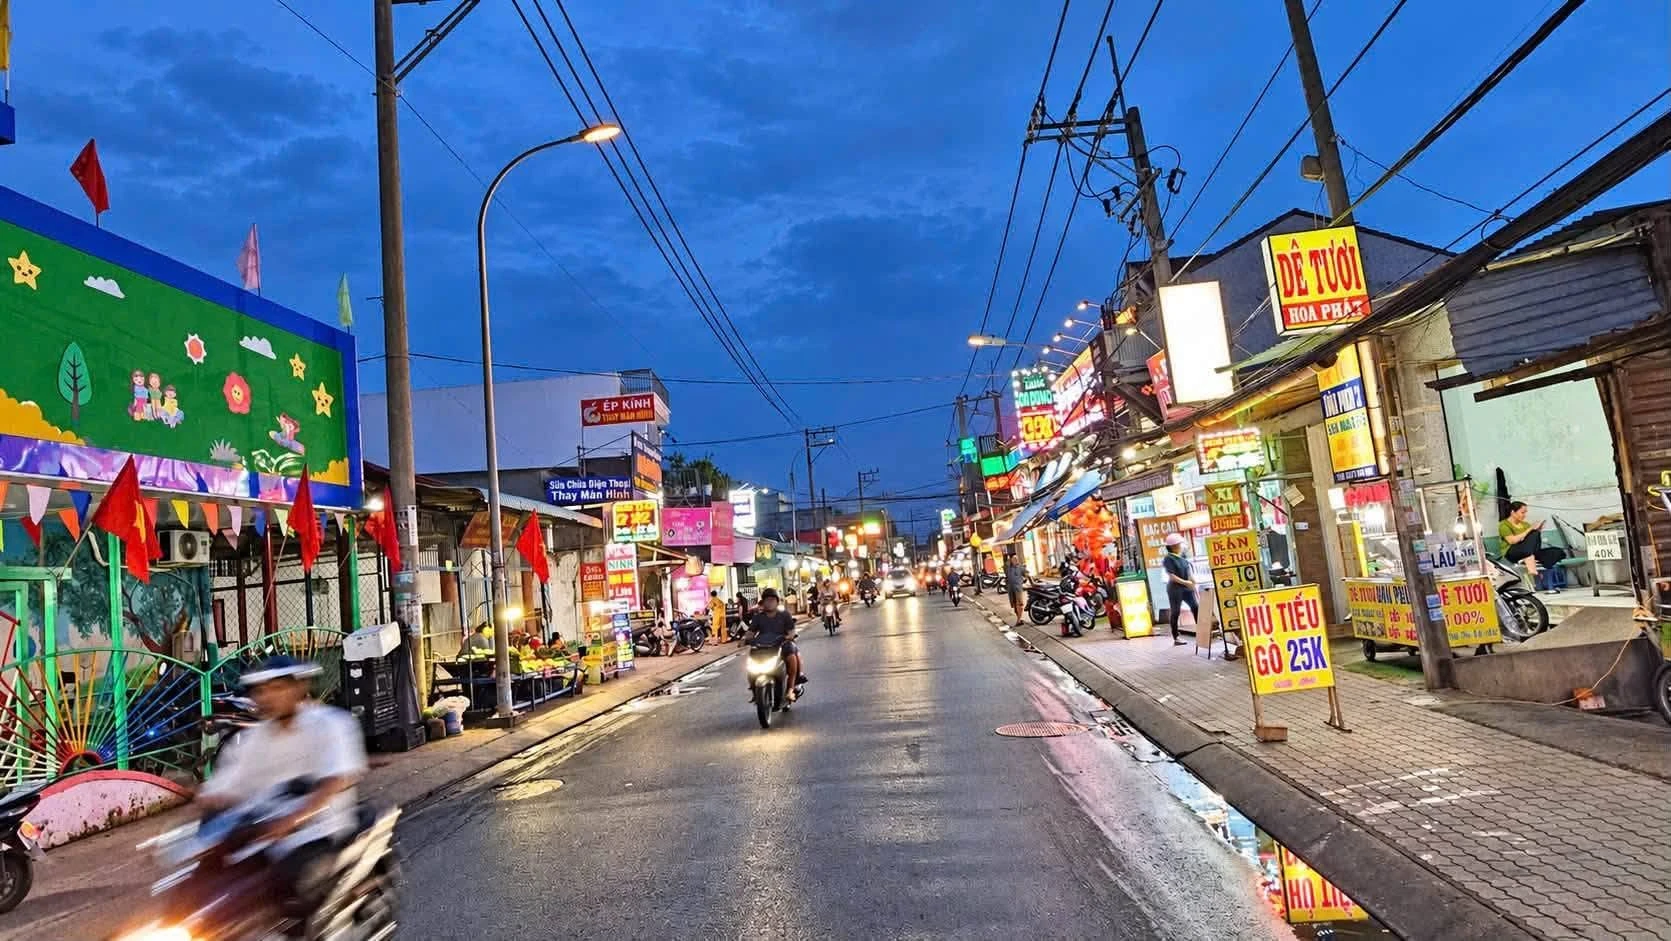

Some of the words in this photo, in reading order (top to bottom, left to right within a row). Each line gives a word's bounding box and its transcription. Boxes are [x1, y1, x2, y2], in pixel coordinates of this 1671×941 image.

[1276, 238, 1308, 298] DÊ
[603, 399, 619, 412] ÉP
[622, 397, 651, 410] KÍNH
[551, 490, 577, 502] Thay
[1245, 595, 1274, 637] HỦ
[1276, 592, 1320, 633] TIẾU
[1286, 635, 1328, 672] 25K
